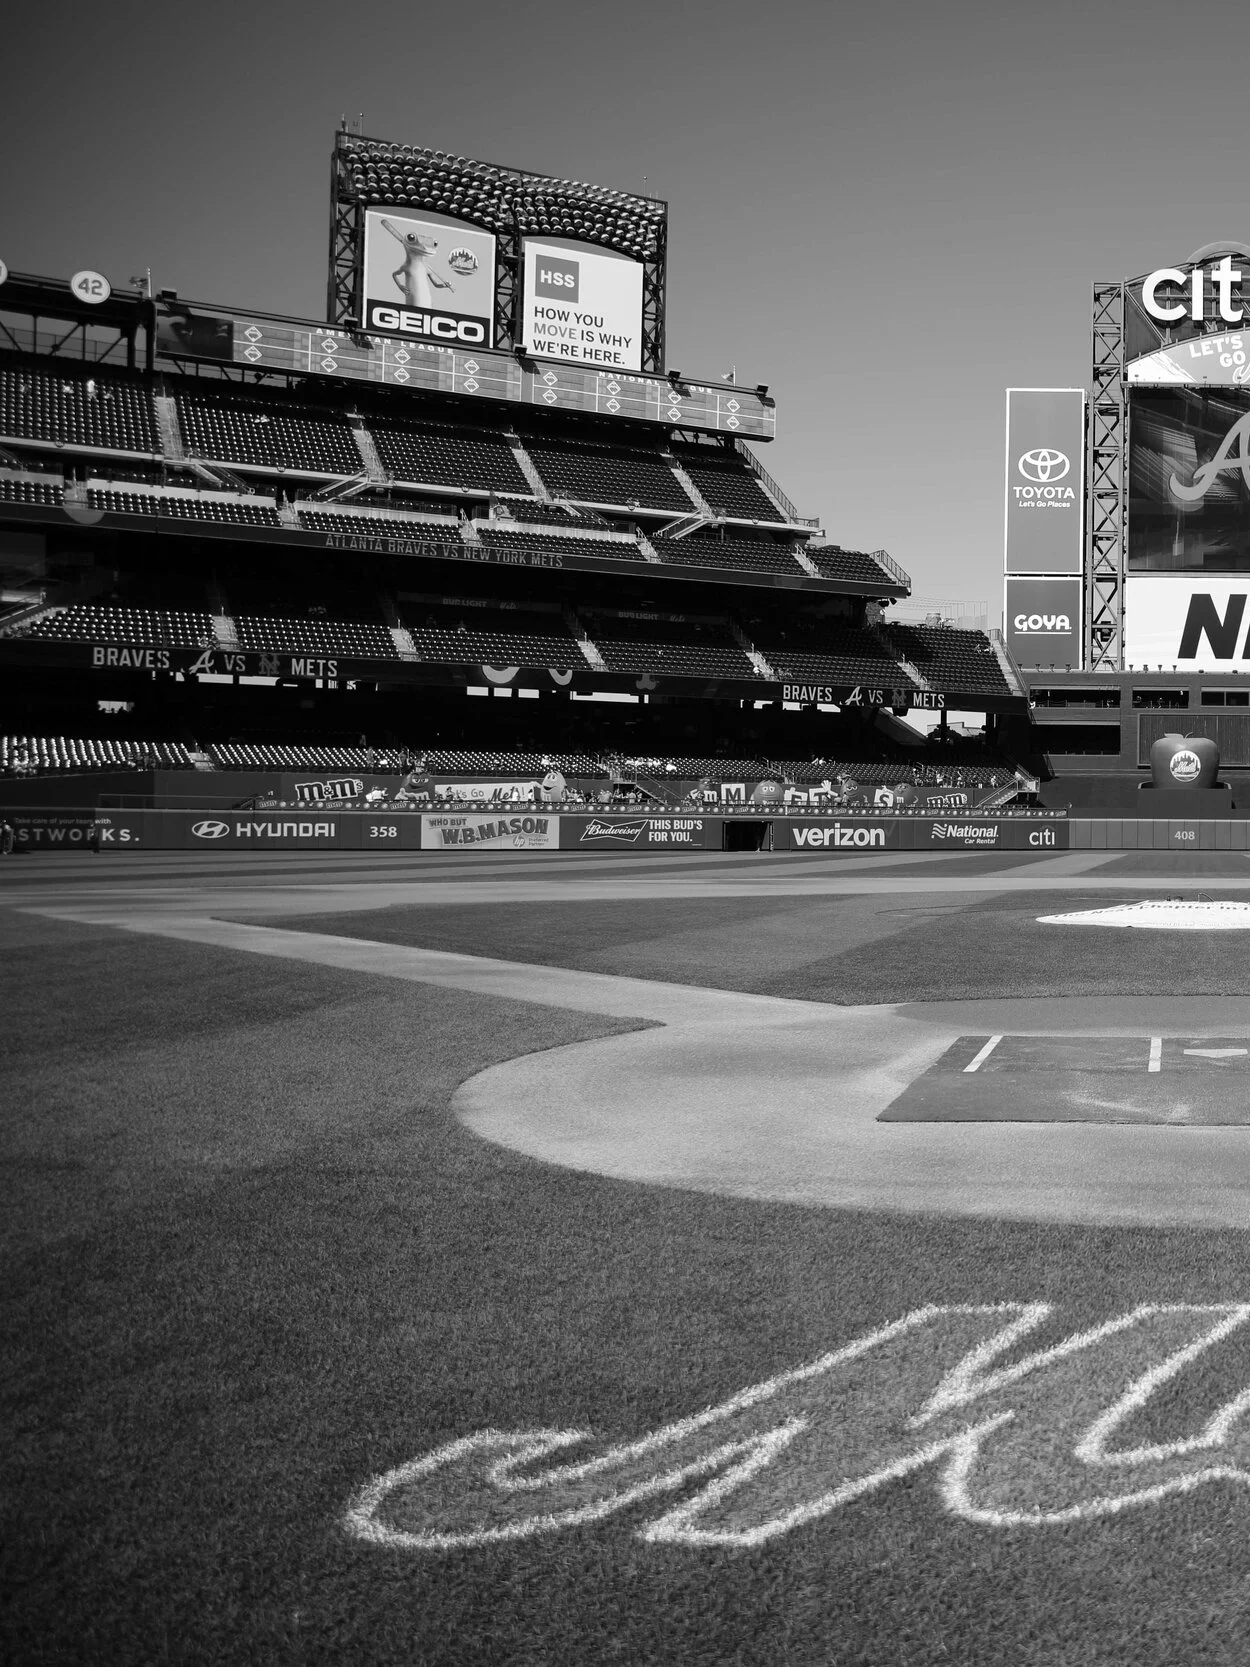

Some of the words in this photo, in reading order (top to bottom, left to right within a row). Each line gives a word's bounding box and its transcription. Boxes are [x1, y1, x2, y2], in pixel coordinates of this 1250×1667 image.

[78, 278, 104, 296] 42
[540, 270, 575, 288] HSS
[372, 307, 485, 343] GEICO
[534, 306, 570, 325] HOW
[574, 313, 604, 328] YOU
[534, 322, 578, 340] MOVE
[580, 329, 594, 342] IS
[598, 333, 632, 348] WHY
[400, 341, 454, 355] LEAGUE
[533, 339, 579, 357] WE'RE
[583, 346, 626, 365] HERE.
[1188, 335, 1243, 358] LET'S
[1220, 350, 1246, 367] GO
[598, 371, 660, 386] NATIONAL
[1013, 487, 1075, 499] TOYOTA
[325, 534, 382, 551] ATLANTA
[388, 539, 437, 557] BRAVES
[442, 545, 458, 558] VS
[463, 547, 491, 561] NEW
[495, 550, 526, 565] YORK
[531, 554, 563, 568] METS
[93, 647, 170, 668] BRAVES
[224, 654, 246, 672] VS
[291, 658, 338, 677] METS
[783, 685, 832, 702] BRAVES
[868, 690, 883, 704] VS
[913, 692, 945, 708] METS
[236, 823, 335, 837] HYUNDAI
[429, 819, 448, 827] WHO
[450, 818, 467, 826] BUT
[586, 823, 642, 838] Budweiser
[648, 819, 671, 830] THIS
[673, 819, 703, 830] BUD'S
[370, 826, 397, 838] 358
[648, 831, 669, 842] FOR
[670, 831, 693, 842] YOU.
[793, 823, 885, 847] verizon
[1029, 828, 1055, 845] citi
[1174, 831, 1195, 841] 408
